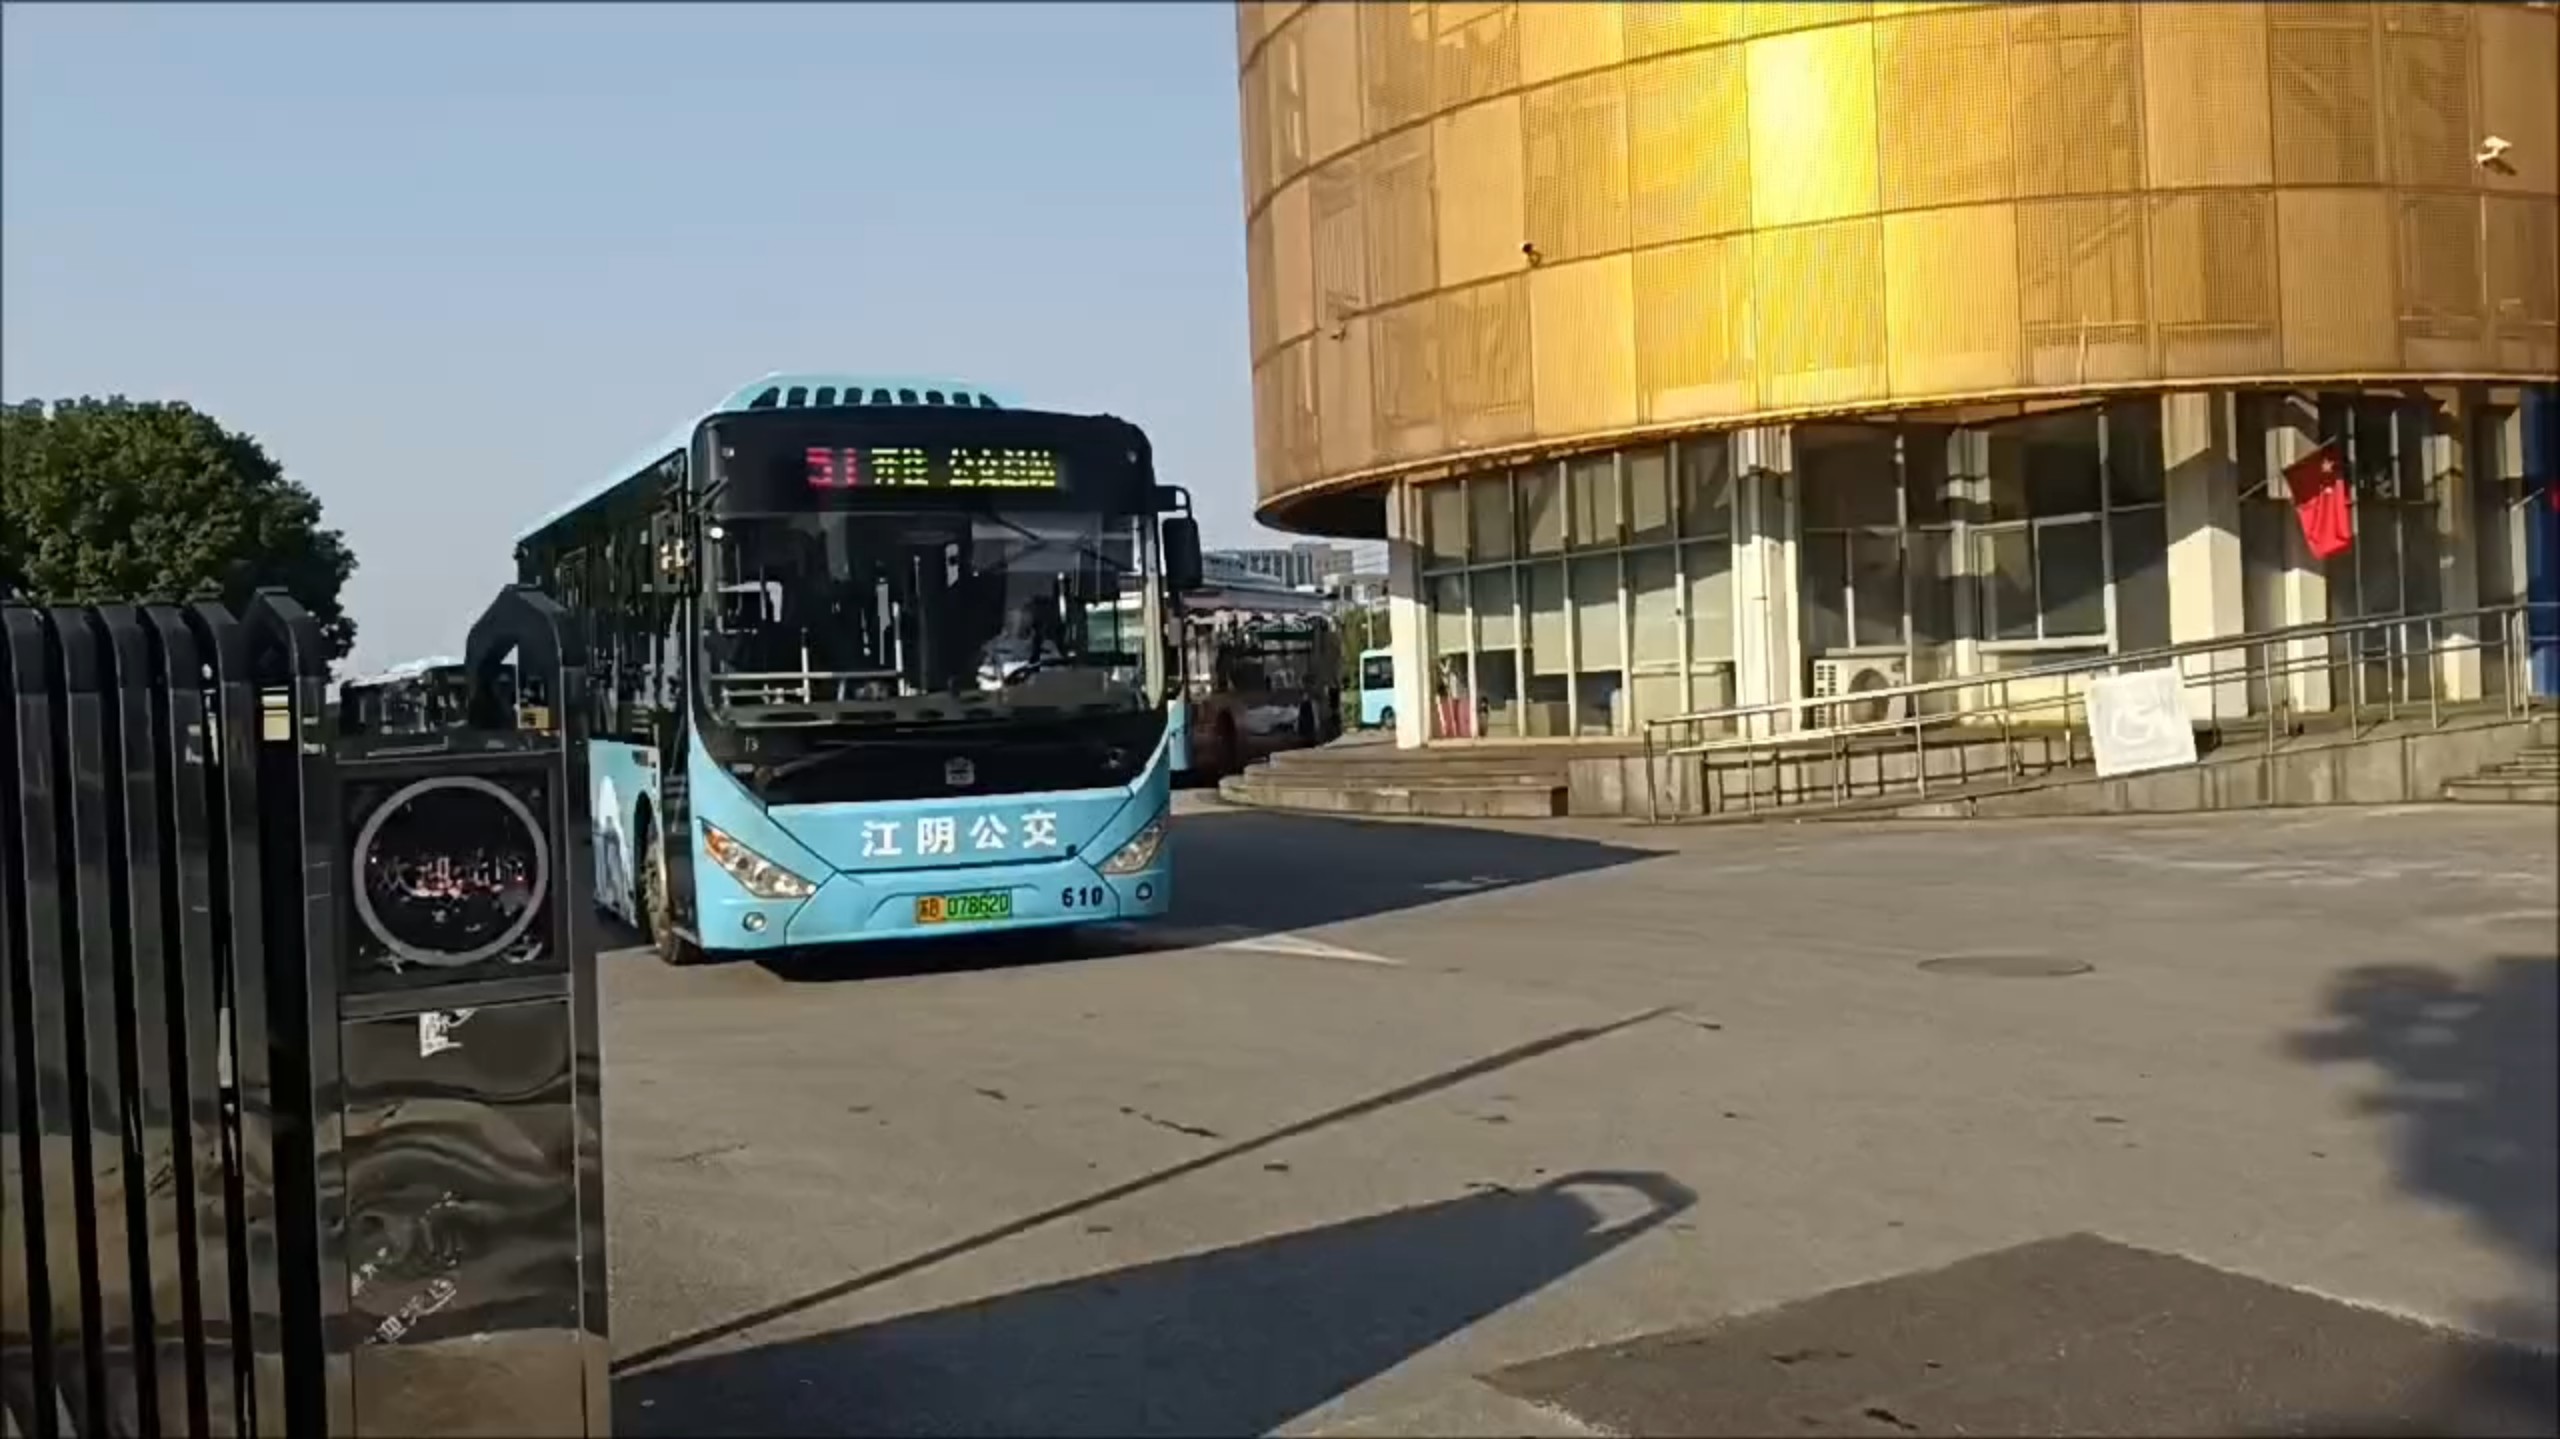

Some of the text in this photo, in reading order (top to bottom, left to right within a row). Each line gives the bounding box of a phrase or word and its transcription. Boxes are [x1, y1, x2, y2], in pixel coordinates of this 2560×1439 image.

[806, 447, 857, 486] 51
[861, 810, 1057, 857] 江阴公交
[1061, 886, 1104, 908] 610
